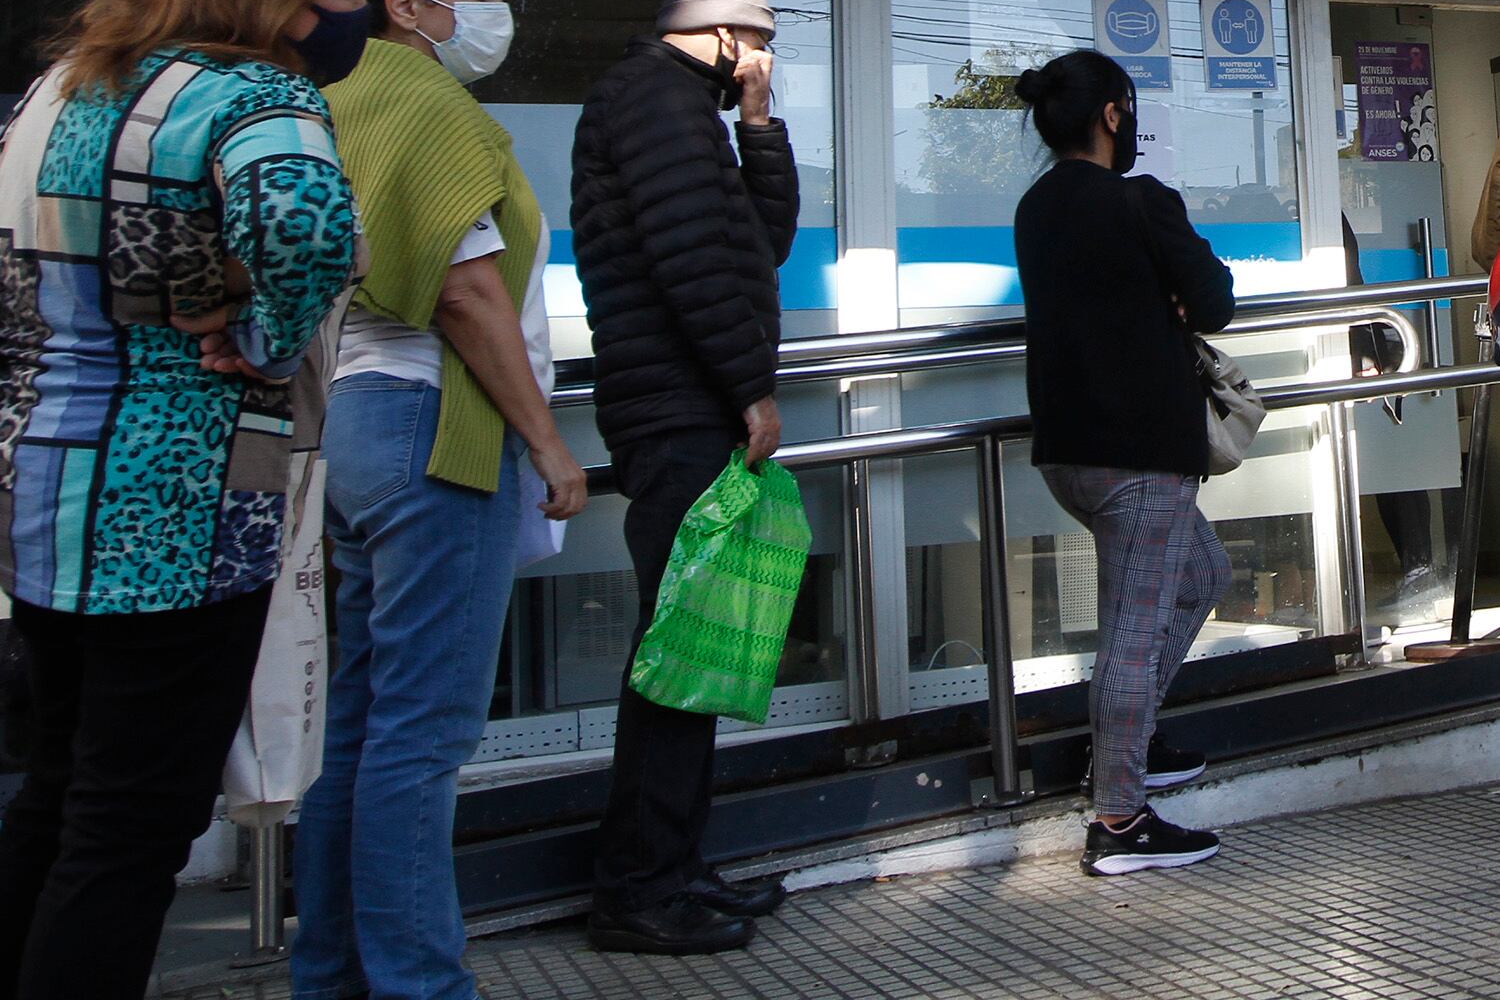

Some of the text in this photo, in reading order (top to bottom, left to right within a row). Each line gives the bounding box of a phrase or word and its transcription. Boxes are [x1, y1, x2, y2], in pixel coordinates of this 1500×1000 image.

[1360, 66, 1393, 75] ACTIVEMOS
[1360, 76, 1429, 86] CONTRA LAS VIOLENCIAS
[1361, 87, 1370, 95] DE
[1368, 149, 1398, 157] ANSES
